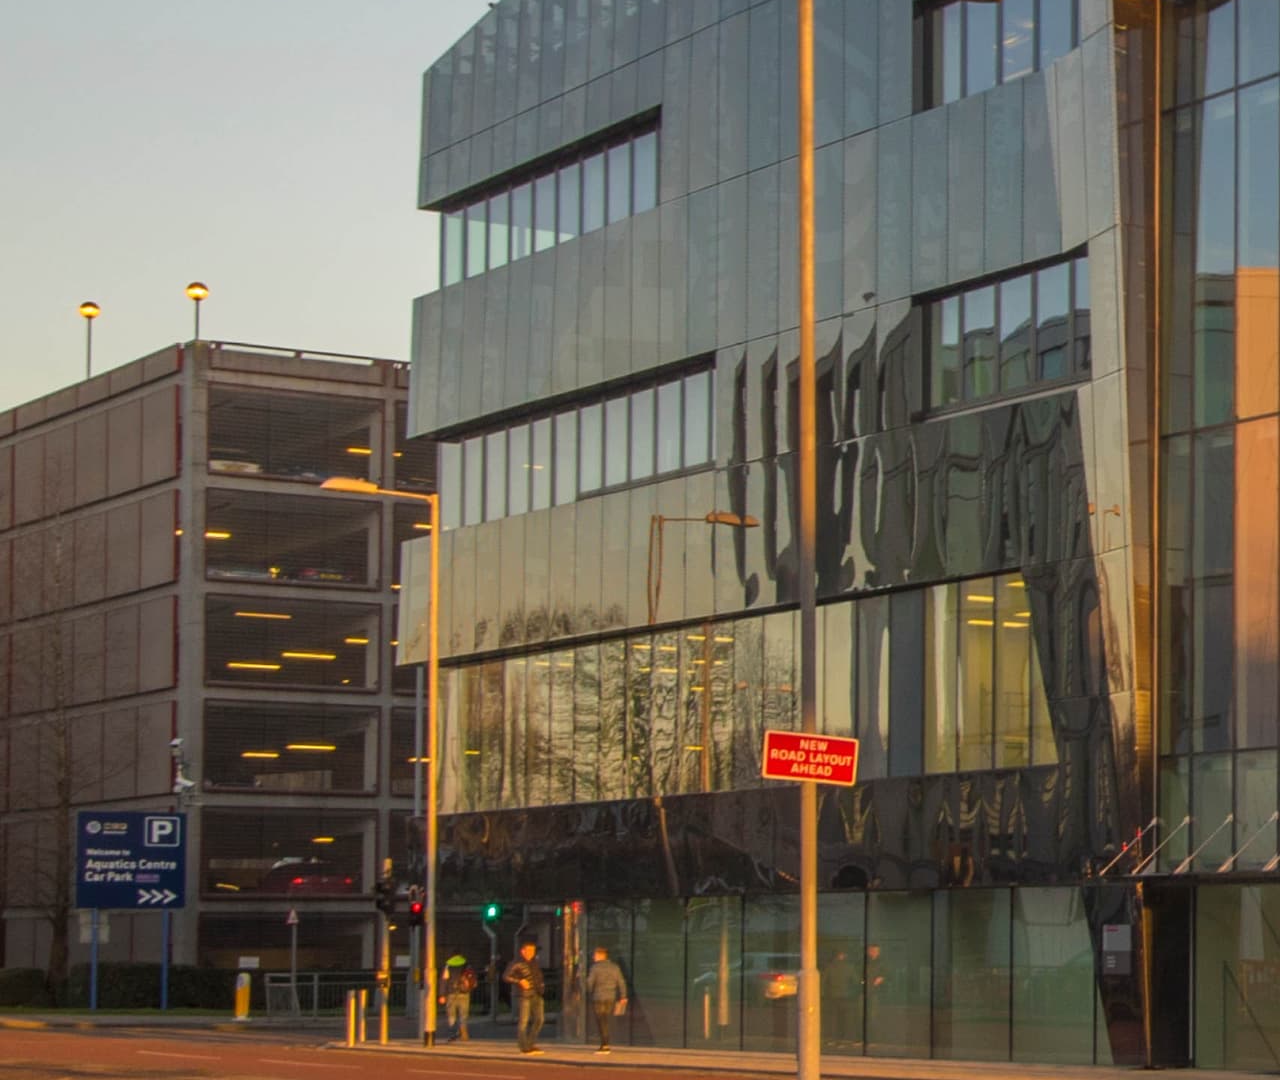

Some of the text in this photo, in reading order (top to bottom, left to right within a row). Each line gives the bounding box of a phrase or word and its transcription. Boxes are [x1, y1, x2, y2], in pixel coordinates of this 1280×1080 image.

[800, 739, 828, 752] NEW
[770, 748, 852, 766] ROAD LAYOUT
[791, 763, 832, 776] AHEAD
[151, 820, 173, 843] P
[86, 859, 177, 871] Aquatics Centre
[85, 871, 104, 882] Car
[106, 871, 133, 882] Park
